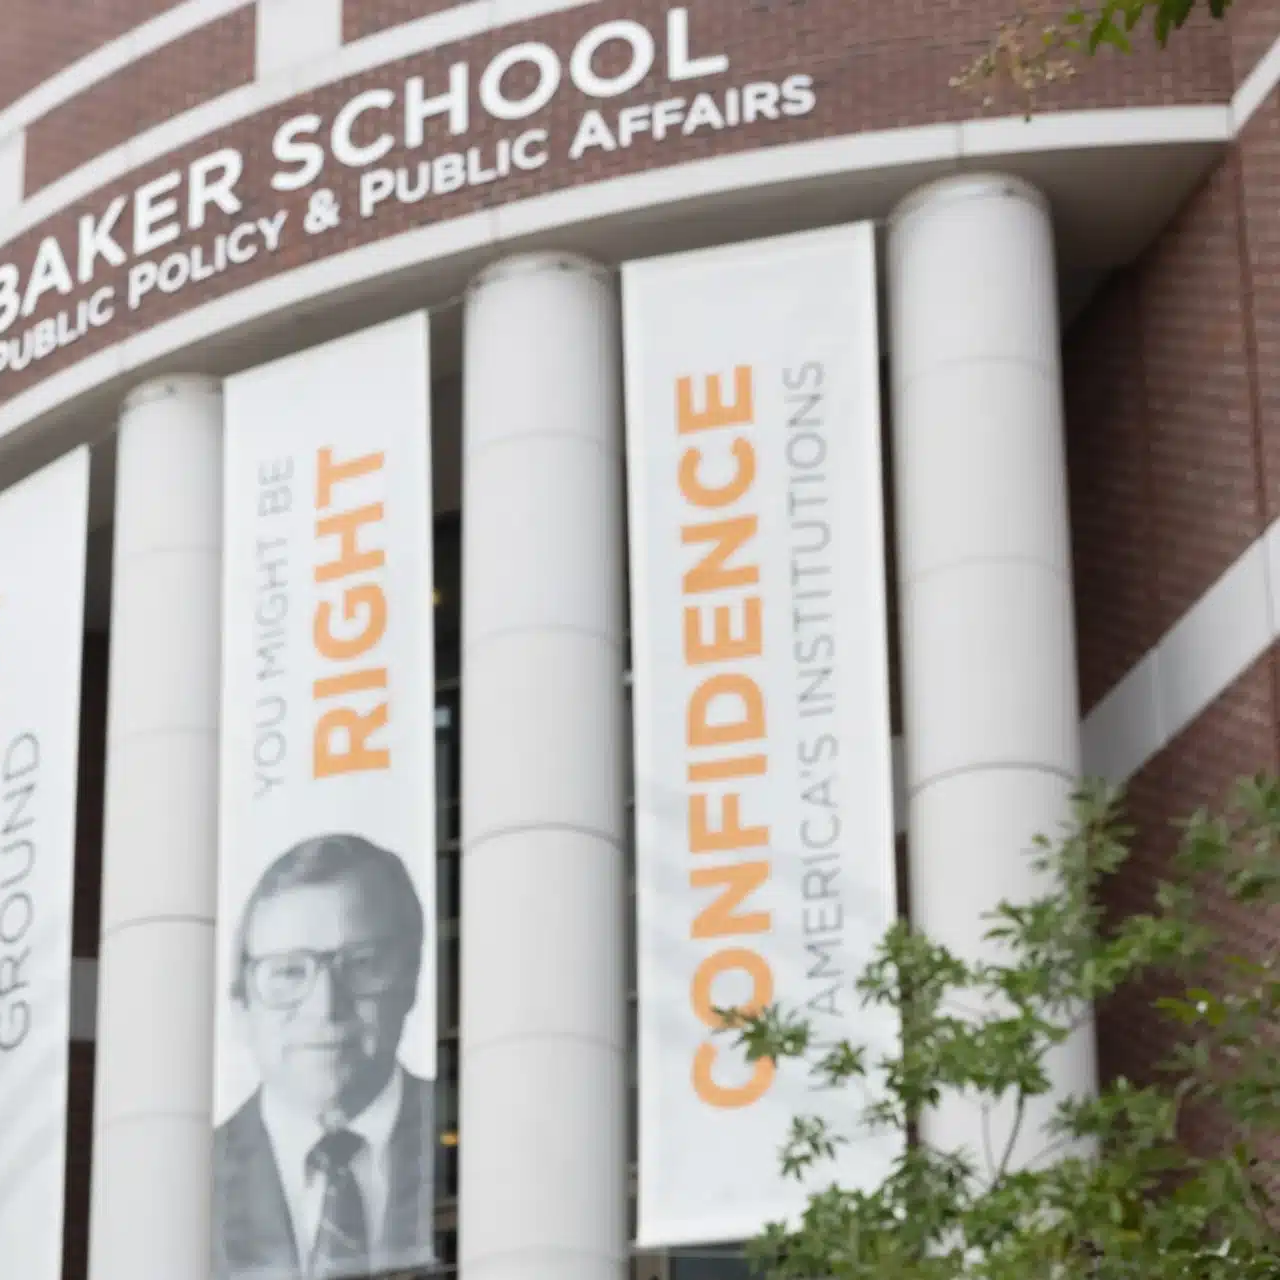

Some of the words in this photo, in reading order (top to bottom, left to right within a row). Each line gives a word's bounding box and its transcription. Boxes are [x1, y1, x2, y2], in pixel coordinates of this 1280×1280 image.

[127, 211, 288, 311] POLICY
[303, 189, 340, 236] &
[360, 128, 548, 217] PUBLIC
[569, 74, 817, 160] AFFAIRS
[270, 8, 728, 191] SCHOOL
[258, 455, 294, 516] BE
[782, 360, 838, 719] INSTITUTIONS
[255, 537, 288, 680] MIGHT
[313, 446, 391, 779] RIGHT
[253, 695, 287, 799] YOU
[675, 364, 775, 1110] CONFIDENCE
[797, 732, 844, 1018] AMERICA'S
